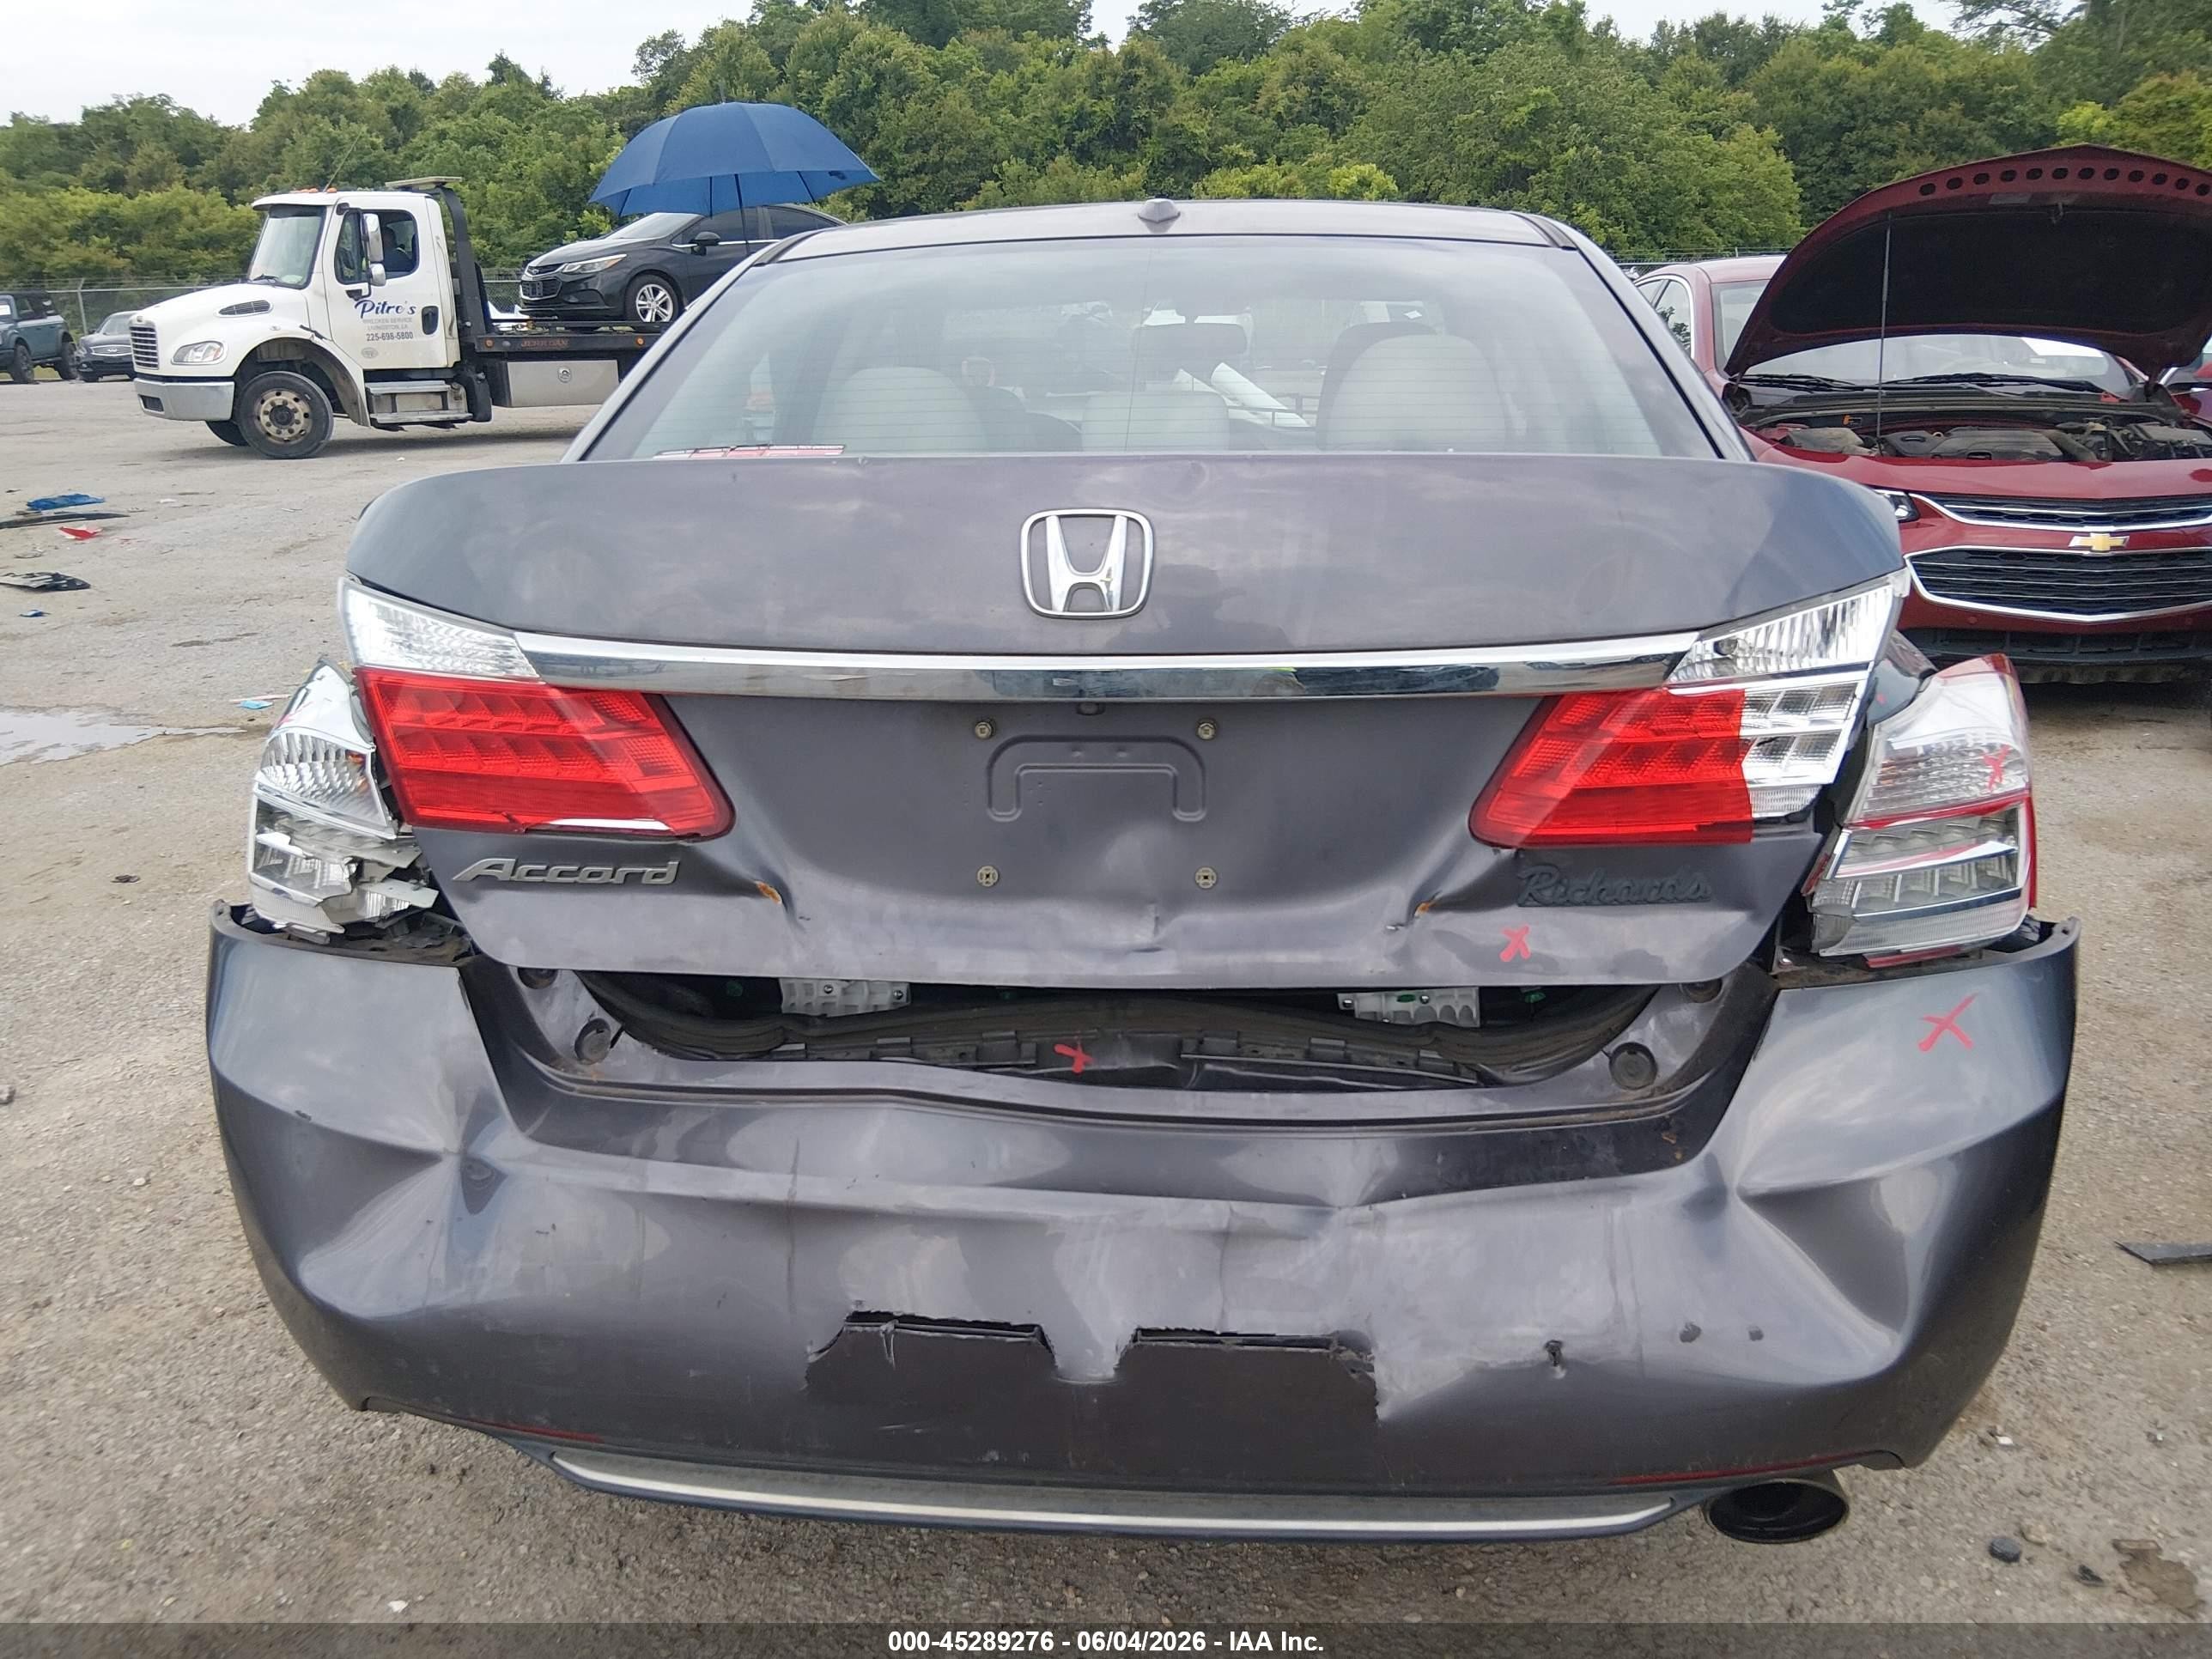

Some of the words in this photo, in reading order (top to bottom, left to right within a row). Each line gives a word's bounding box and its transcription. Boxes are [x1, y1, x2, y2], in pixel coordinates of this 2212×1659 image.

[355, 299, 416, 319] Pitre's
[366, 331, 414, 341] 225-698-5800
[453, 858, 679, 884] Accord
